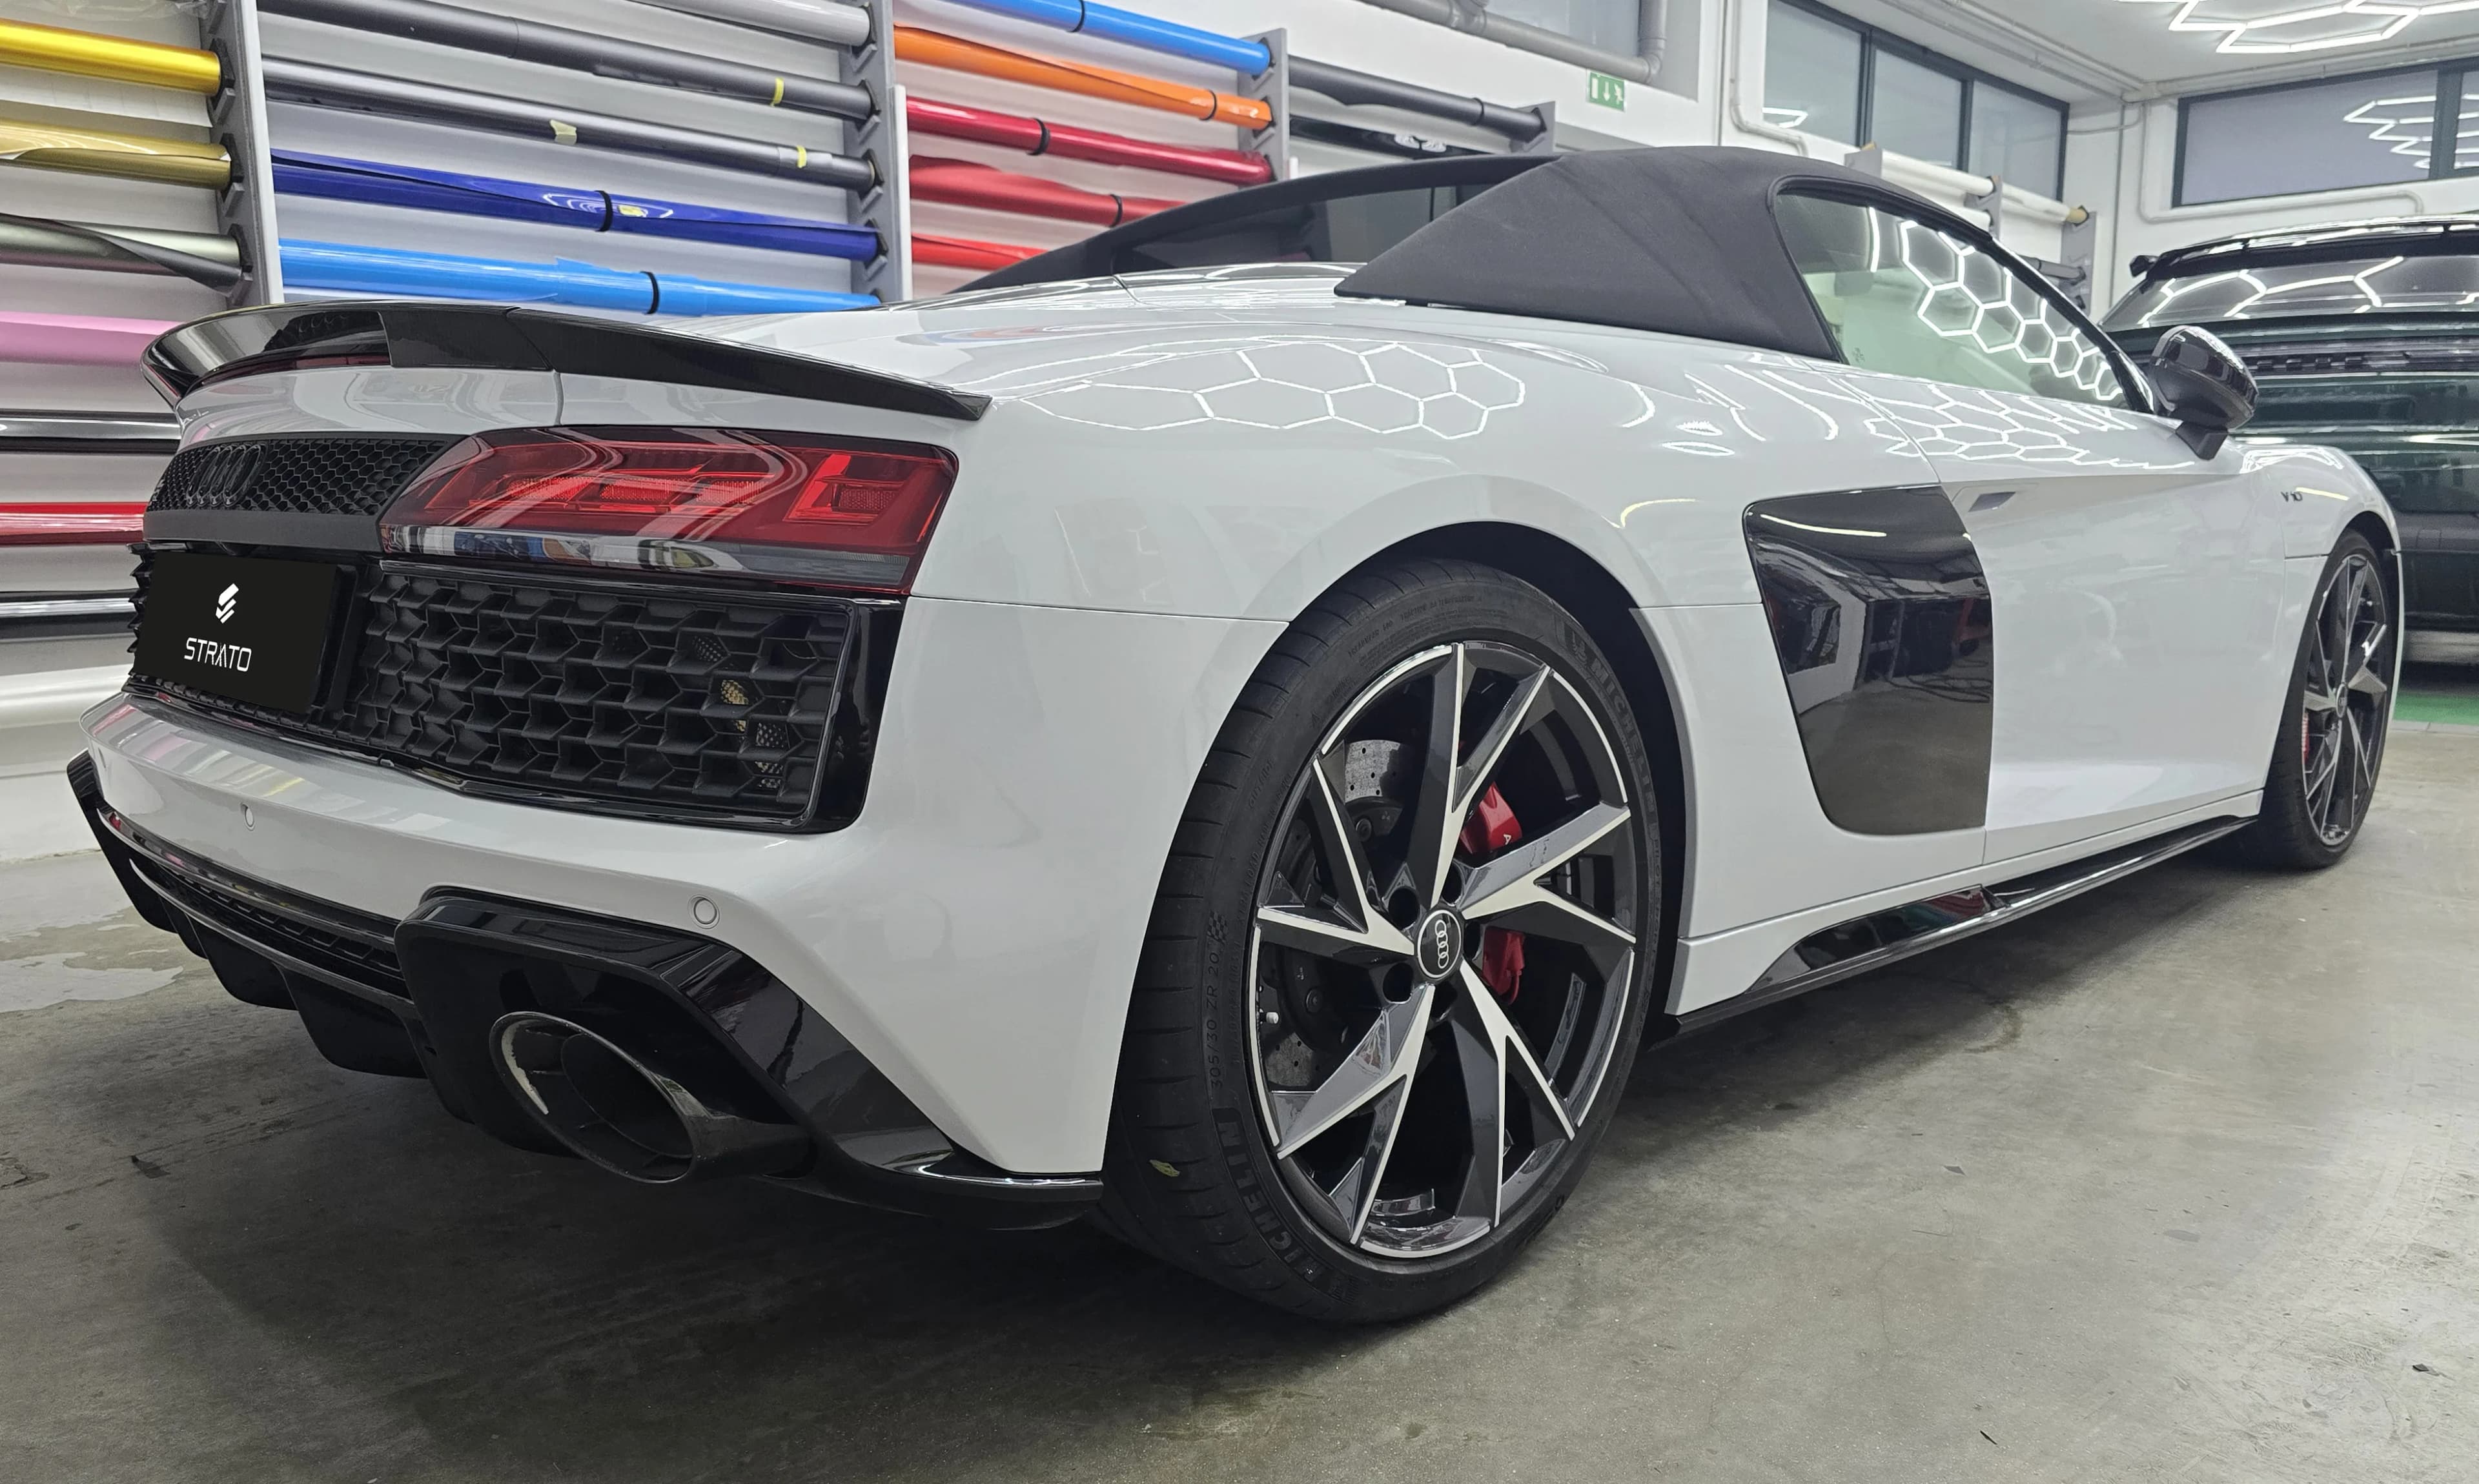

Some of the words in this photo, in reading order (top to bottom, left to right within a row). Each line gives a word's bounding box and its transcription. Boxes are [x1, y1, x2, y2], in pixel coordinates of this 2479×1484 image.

[1591, 656, 1656, 814] MICHELIN
[1206, 984, 1218, 1010] ZR
[1208, 952, 1219, 977] 20
[1206, 1019, 1223, 1090] 305/30
[1217, 1120, 1322, 1284] MICHELIN
